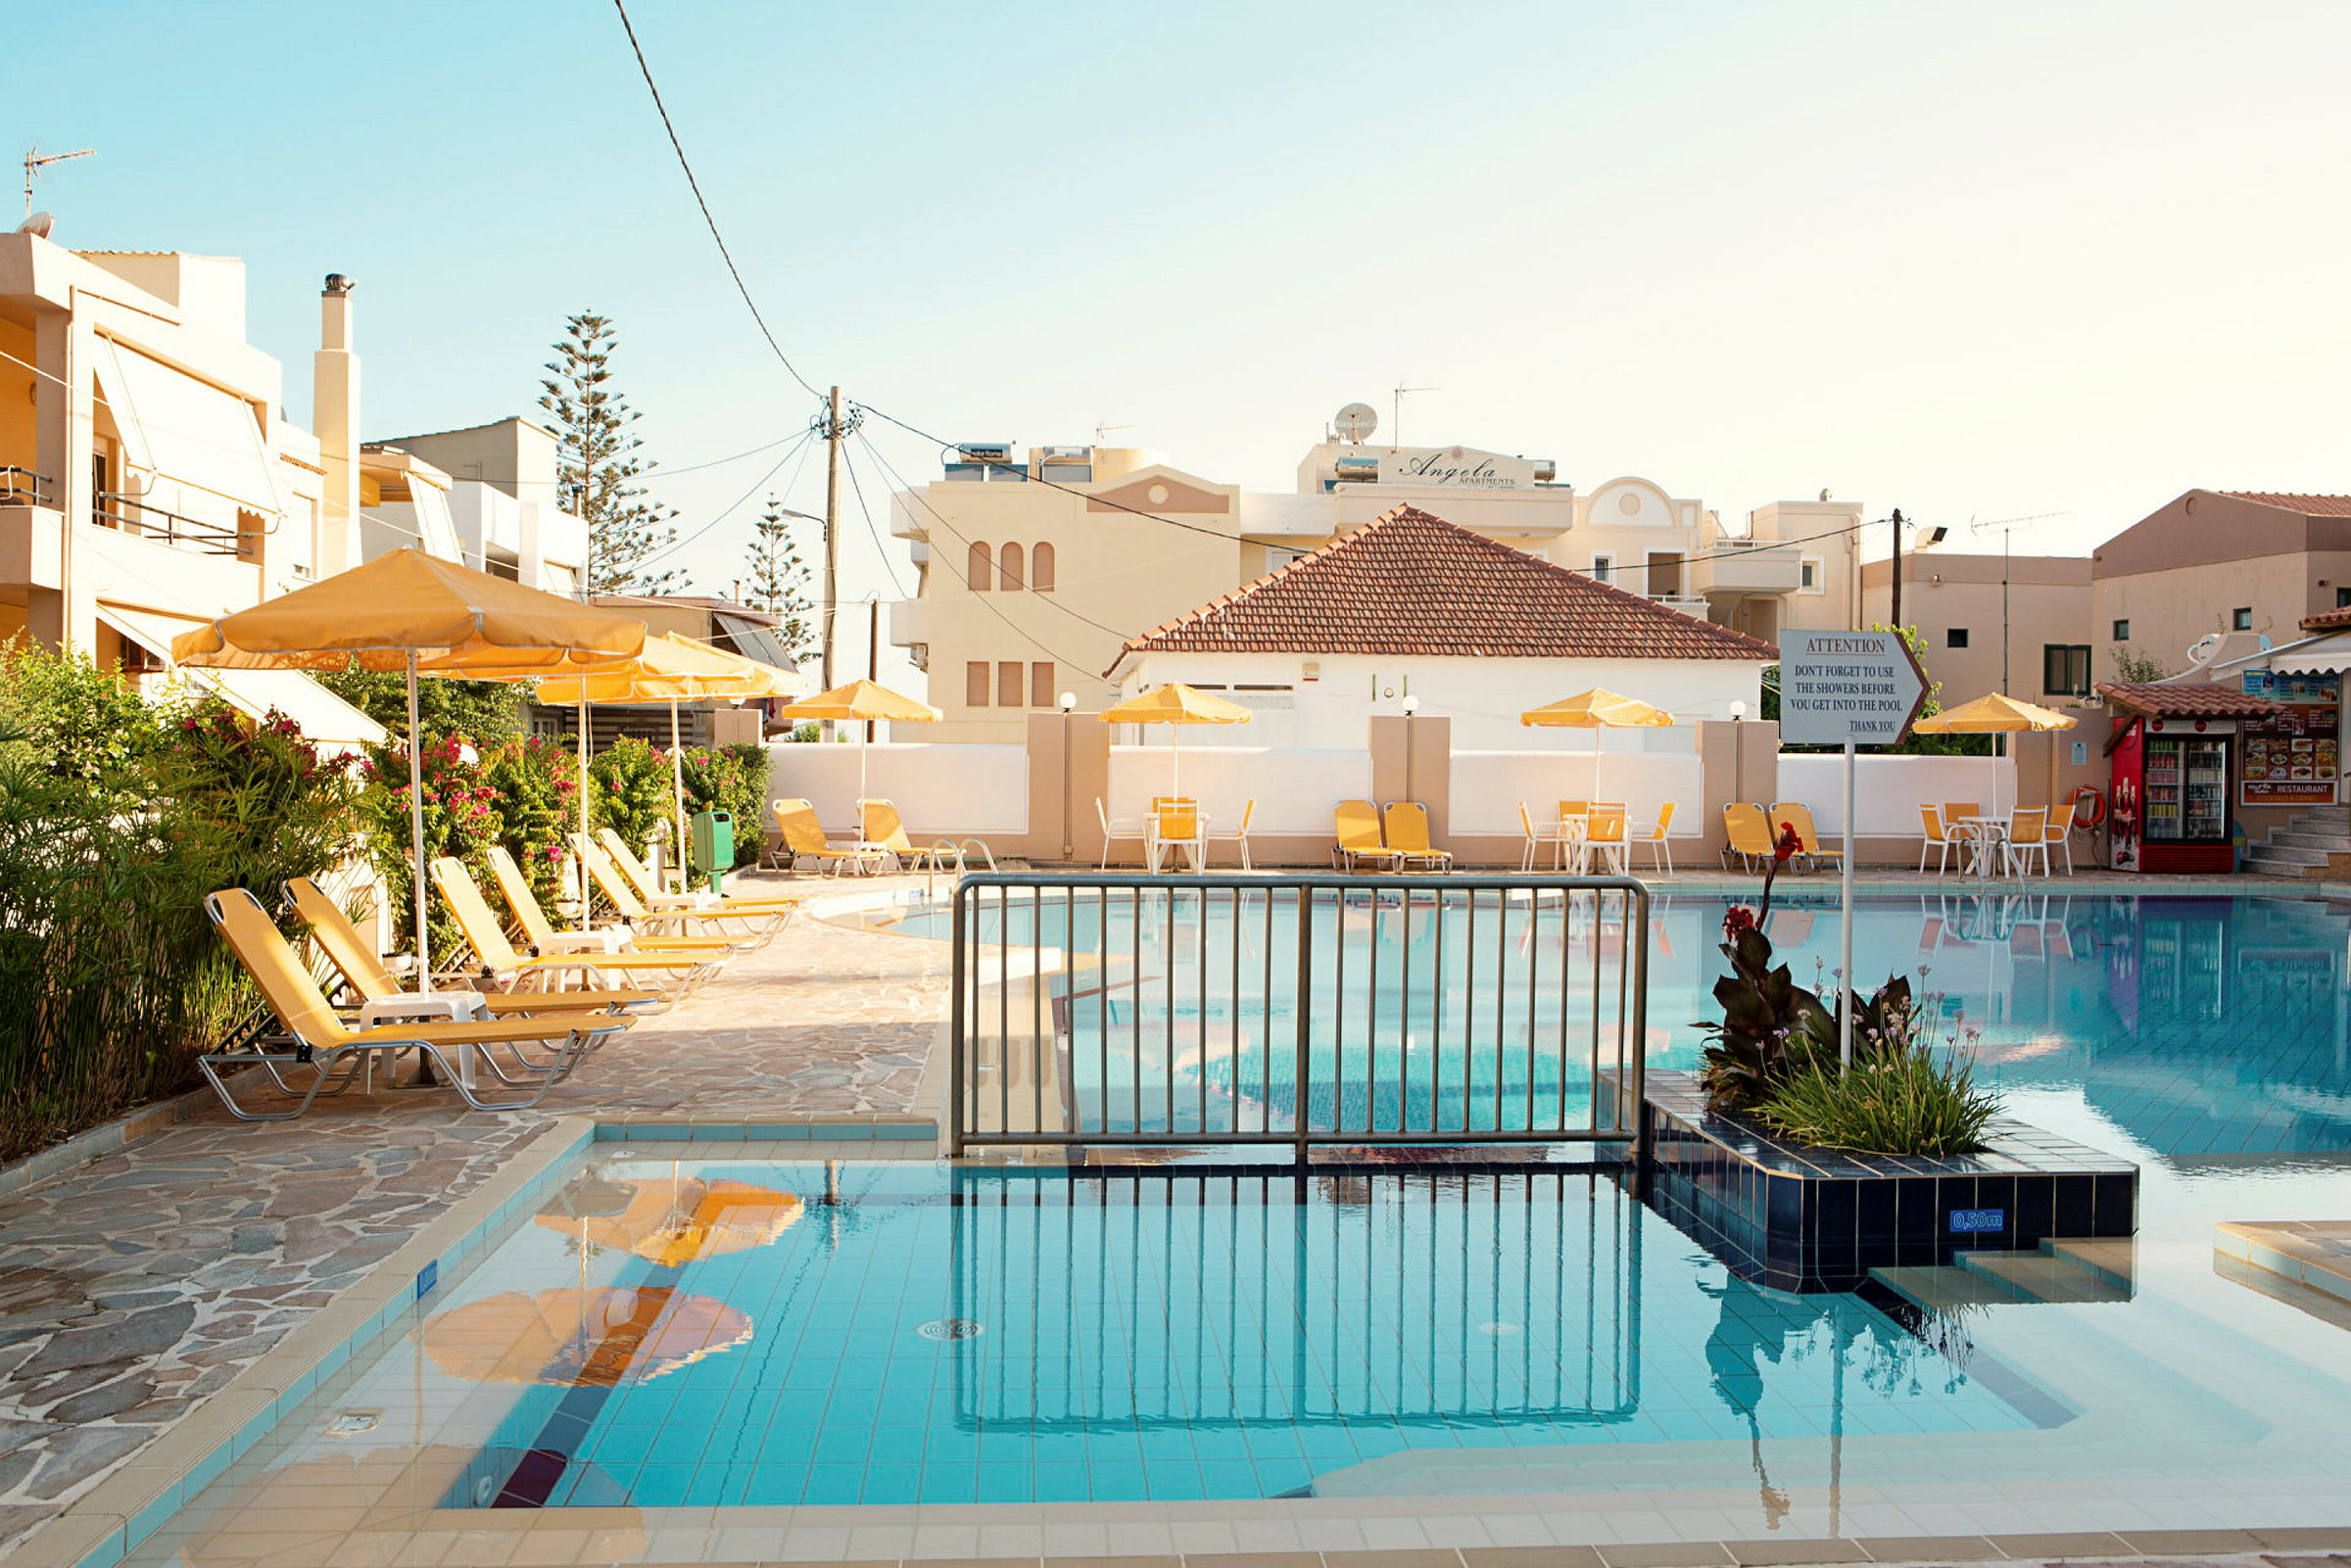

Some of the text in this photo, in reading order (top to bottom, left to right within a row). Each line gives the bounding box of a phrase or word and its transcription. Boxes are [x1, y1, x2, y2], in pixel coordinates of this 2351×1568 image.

[1399, 452, 1496, 484] Angela
[1459, 477, 1515, 486] APARTMENTS
[1806, 638, 1886, 653] ATTENTION
[1795, 665, 1895, 678] DON'T FORGET TO USE
[1796, 682, 1896, 694] THE SHOWERS BEFORE
[1812, 699, 1830, 711] GET
[1833, 699, 1856, 711] INTO
[1858, 699, 1876, 711] THE
[1879, 699, 1903, 711] POOL
[1849, 721, 1896, 733] THANK YOU
[2277, 784, 2328, 793] RESTAURANT
[1953, 1212, 2002, 1230] 0,50m
